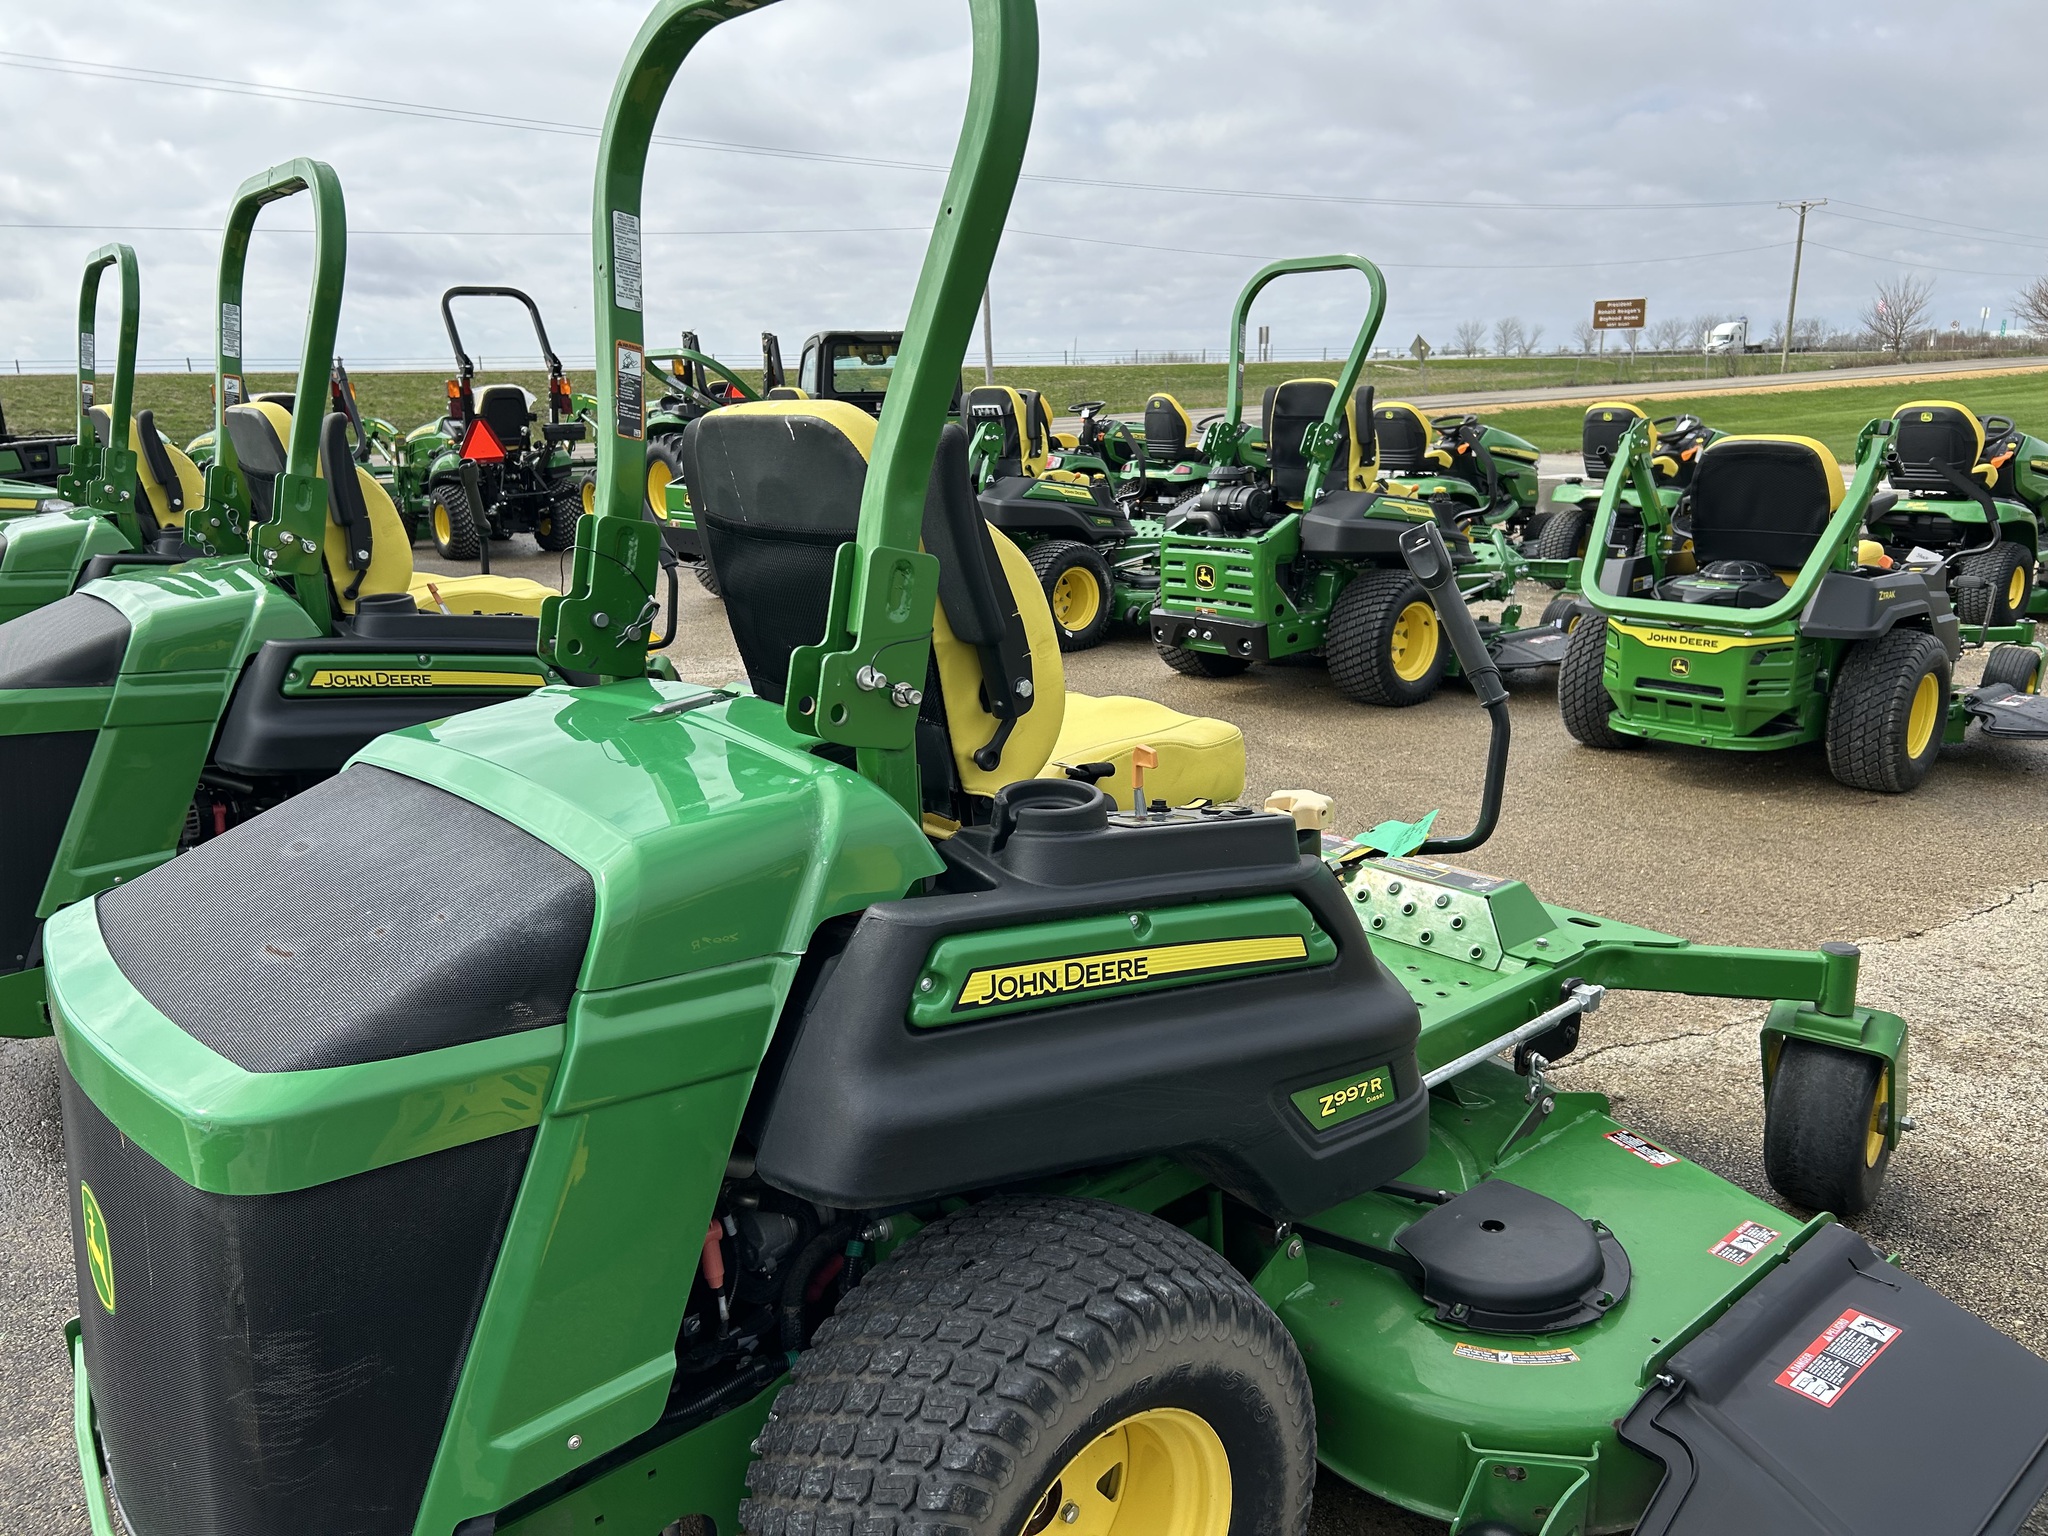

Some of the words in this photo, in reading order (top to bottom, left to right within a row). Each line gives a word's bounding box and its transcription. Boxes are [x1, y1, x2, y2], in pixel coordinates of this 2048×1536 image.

[1878, 590, 1896, 601] ZTRAK
[1646, 632, 1677, 644] JOHN
[1679, 635, 1718, 648] DEERE
[324, 672, 371, 687] JOHN
[376, 672, 433, 686] DEERE
[981, 969, 1057, 1001] JOHN
[1064, 956, 1148, 987] DEERE
[1365, 1091, 1385, 1104] Diesel
[1793, 1352, 1815, 1373] DANGER
[1053, 1361, 1193, 1461] TURF
[1220, 1369, 1276, 1424] 505
